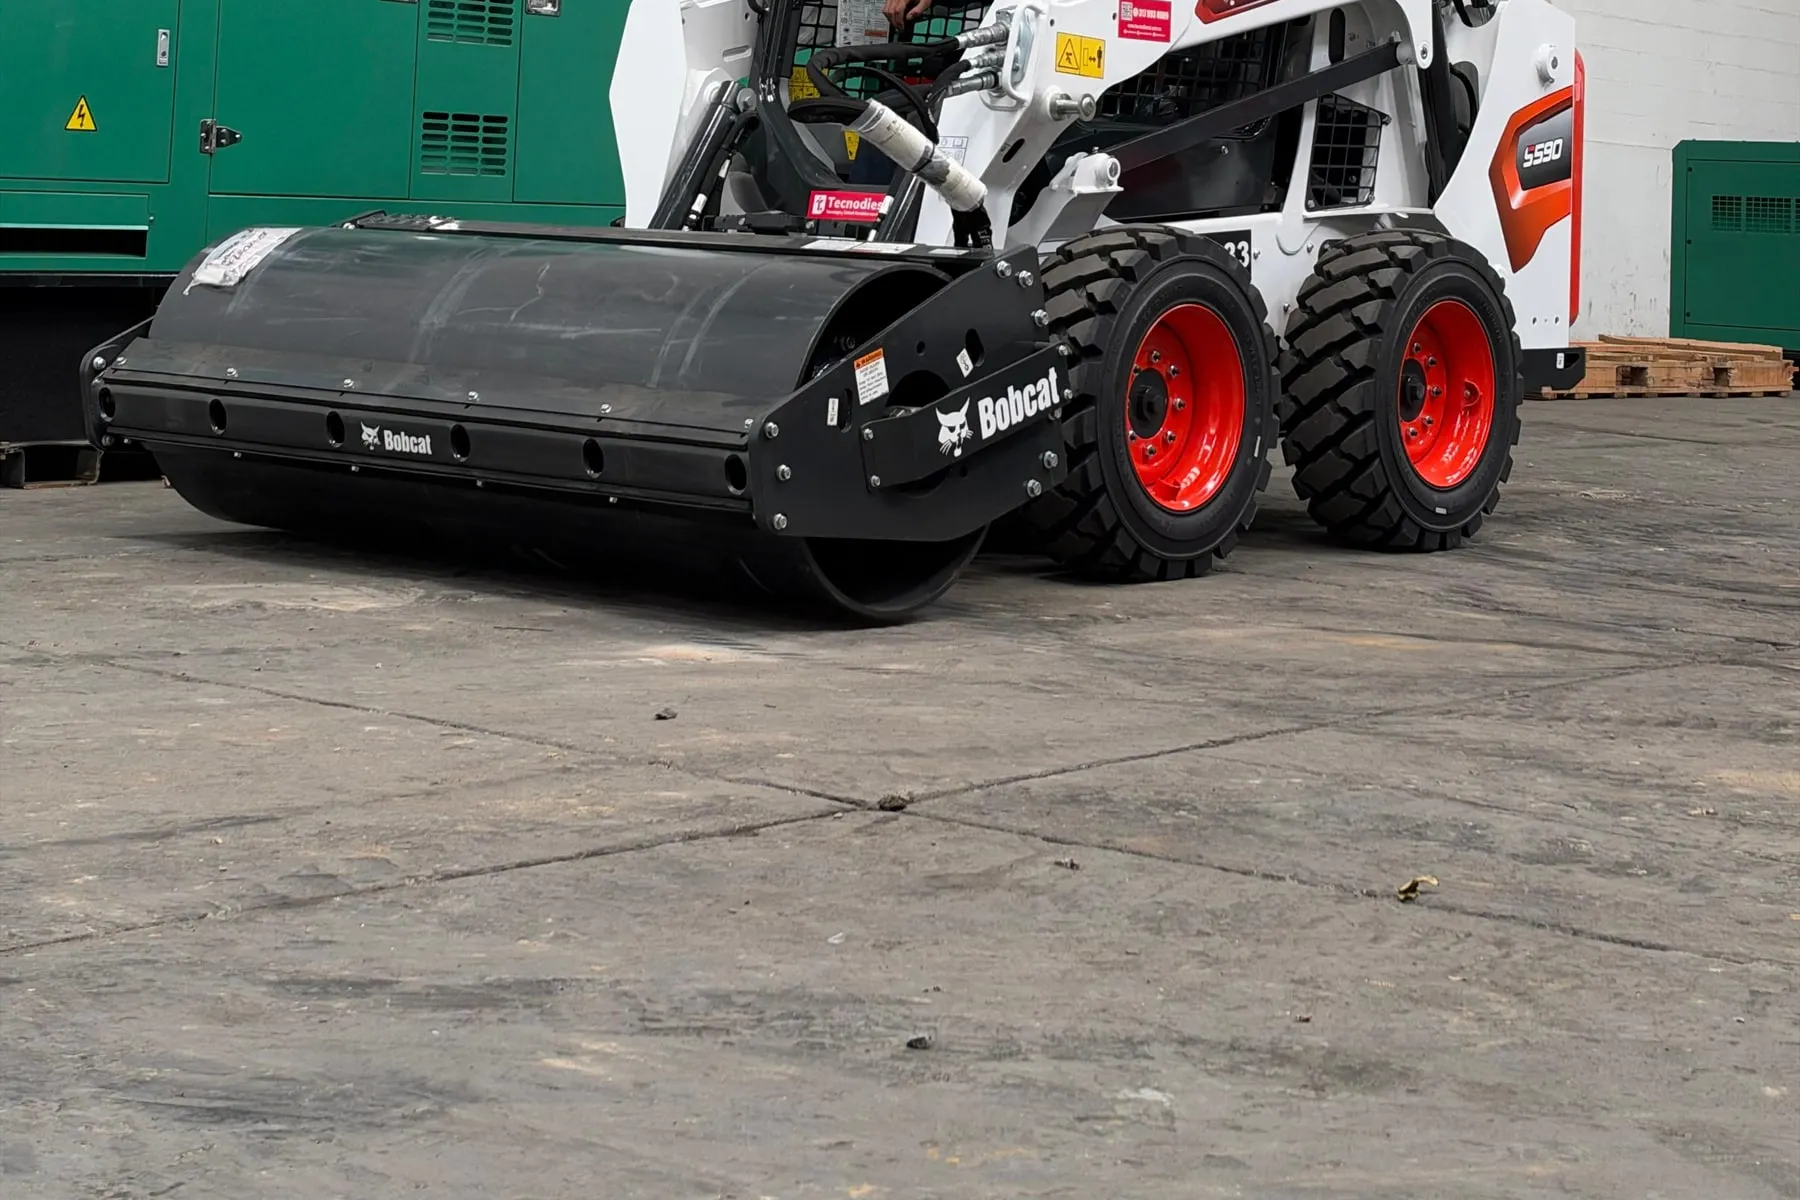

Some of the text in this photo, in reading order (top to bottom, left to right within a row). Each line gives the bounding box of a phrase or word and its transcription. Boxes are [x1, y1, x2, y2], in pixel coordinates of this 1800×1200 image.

[1522, 138, 1563, 168] S590
[827, 196, 883, 210] Tecnodies
[977, 366, 1060, 440] Bobcat
[383, 429, 432, 455] Bobcat
